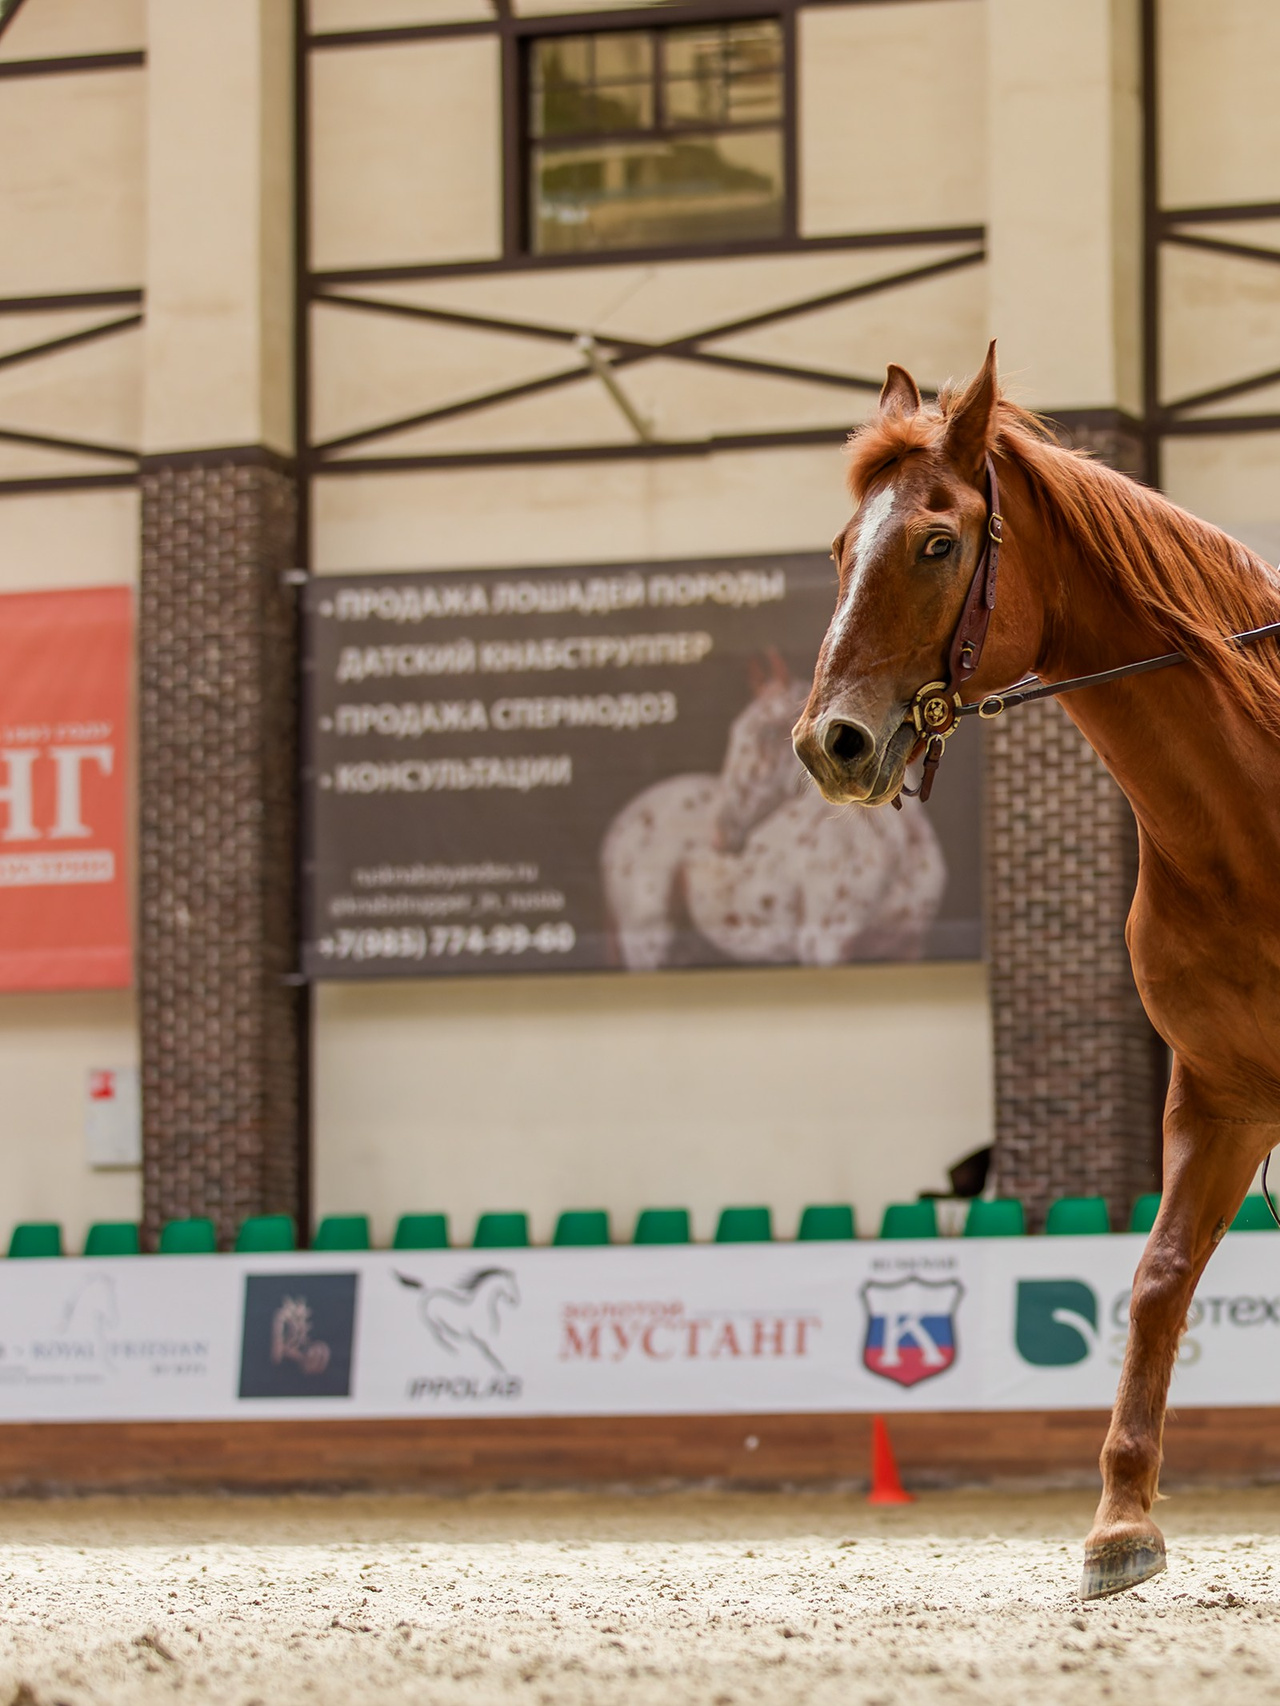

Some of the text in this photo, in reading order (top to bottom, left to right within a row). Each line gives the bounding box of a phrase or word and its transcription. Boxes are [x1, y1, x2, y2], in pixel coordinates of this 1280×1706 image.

[337, 571, 785, 619] ПРОДАЖА ЛОШАДЕЙ ПОРОДЫ
[338, 634, 711, 681] ДАТСКИЙ КНАБСТРУППЕР
[337, 693, 676, 736] ПРОДАЖА СПЕРМОДОЗ
[337, 757, 570, 790] КОНСУЛЬТАЦИИ
[564, 1299, 685, 1319] ЗОЛОТОЙ
[560, 1316, 822, 1360] МУСТАНГ
[405, 1376, 524, 1401] IPPOLAB
